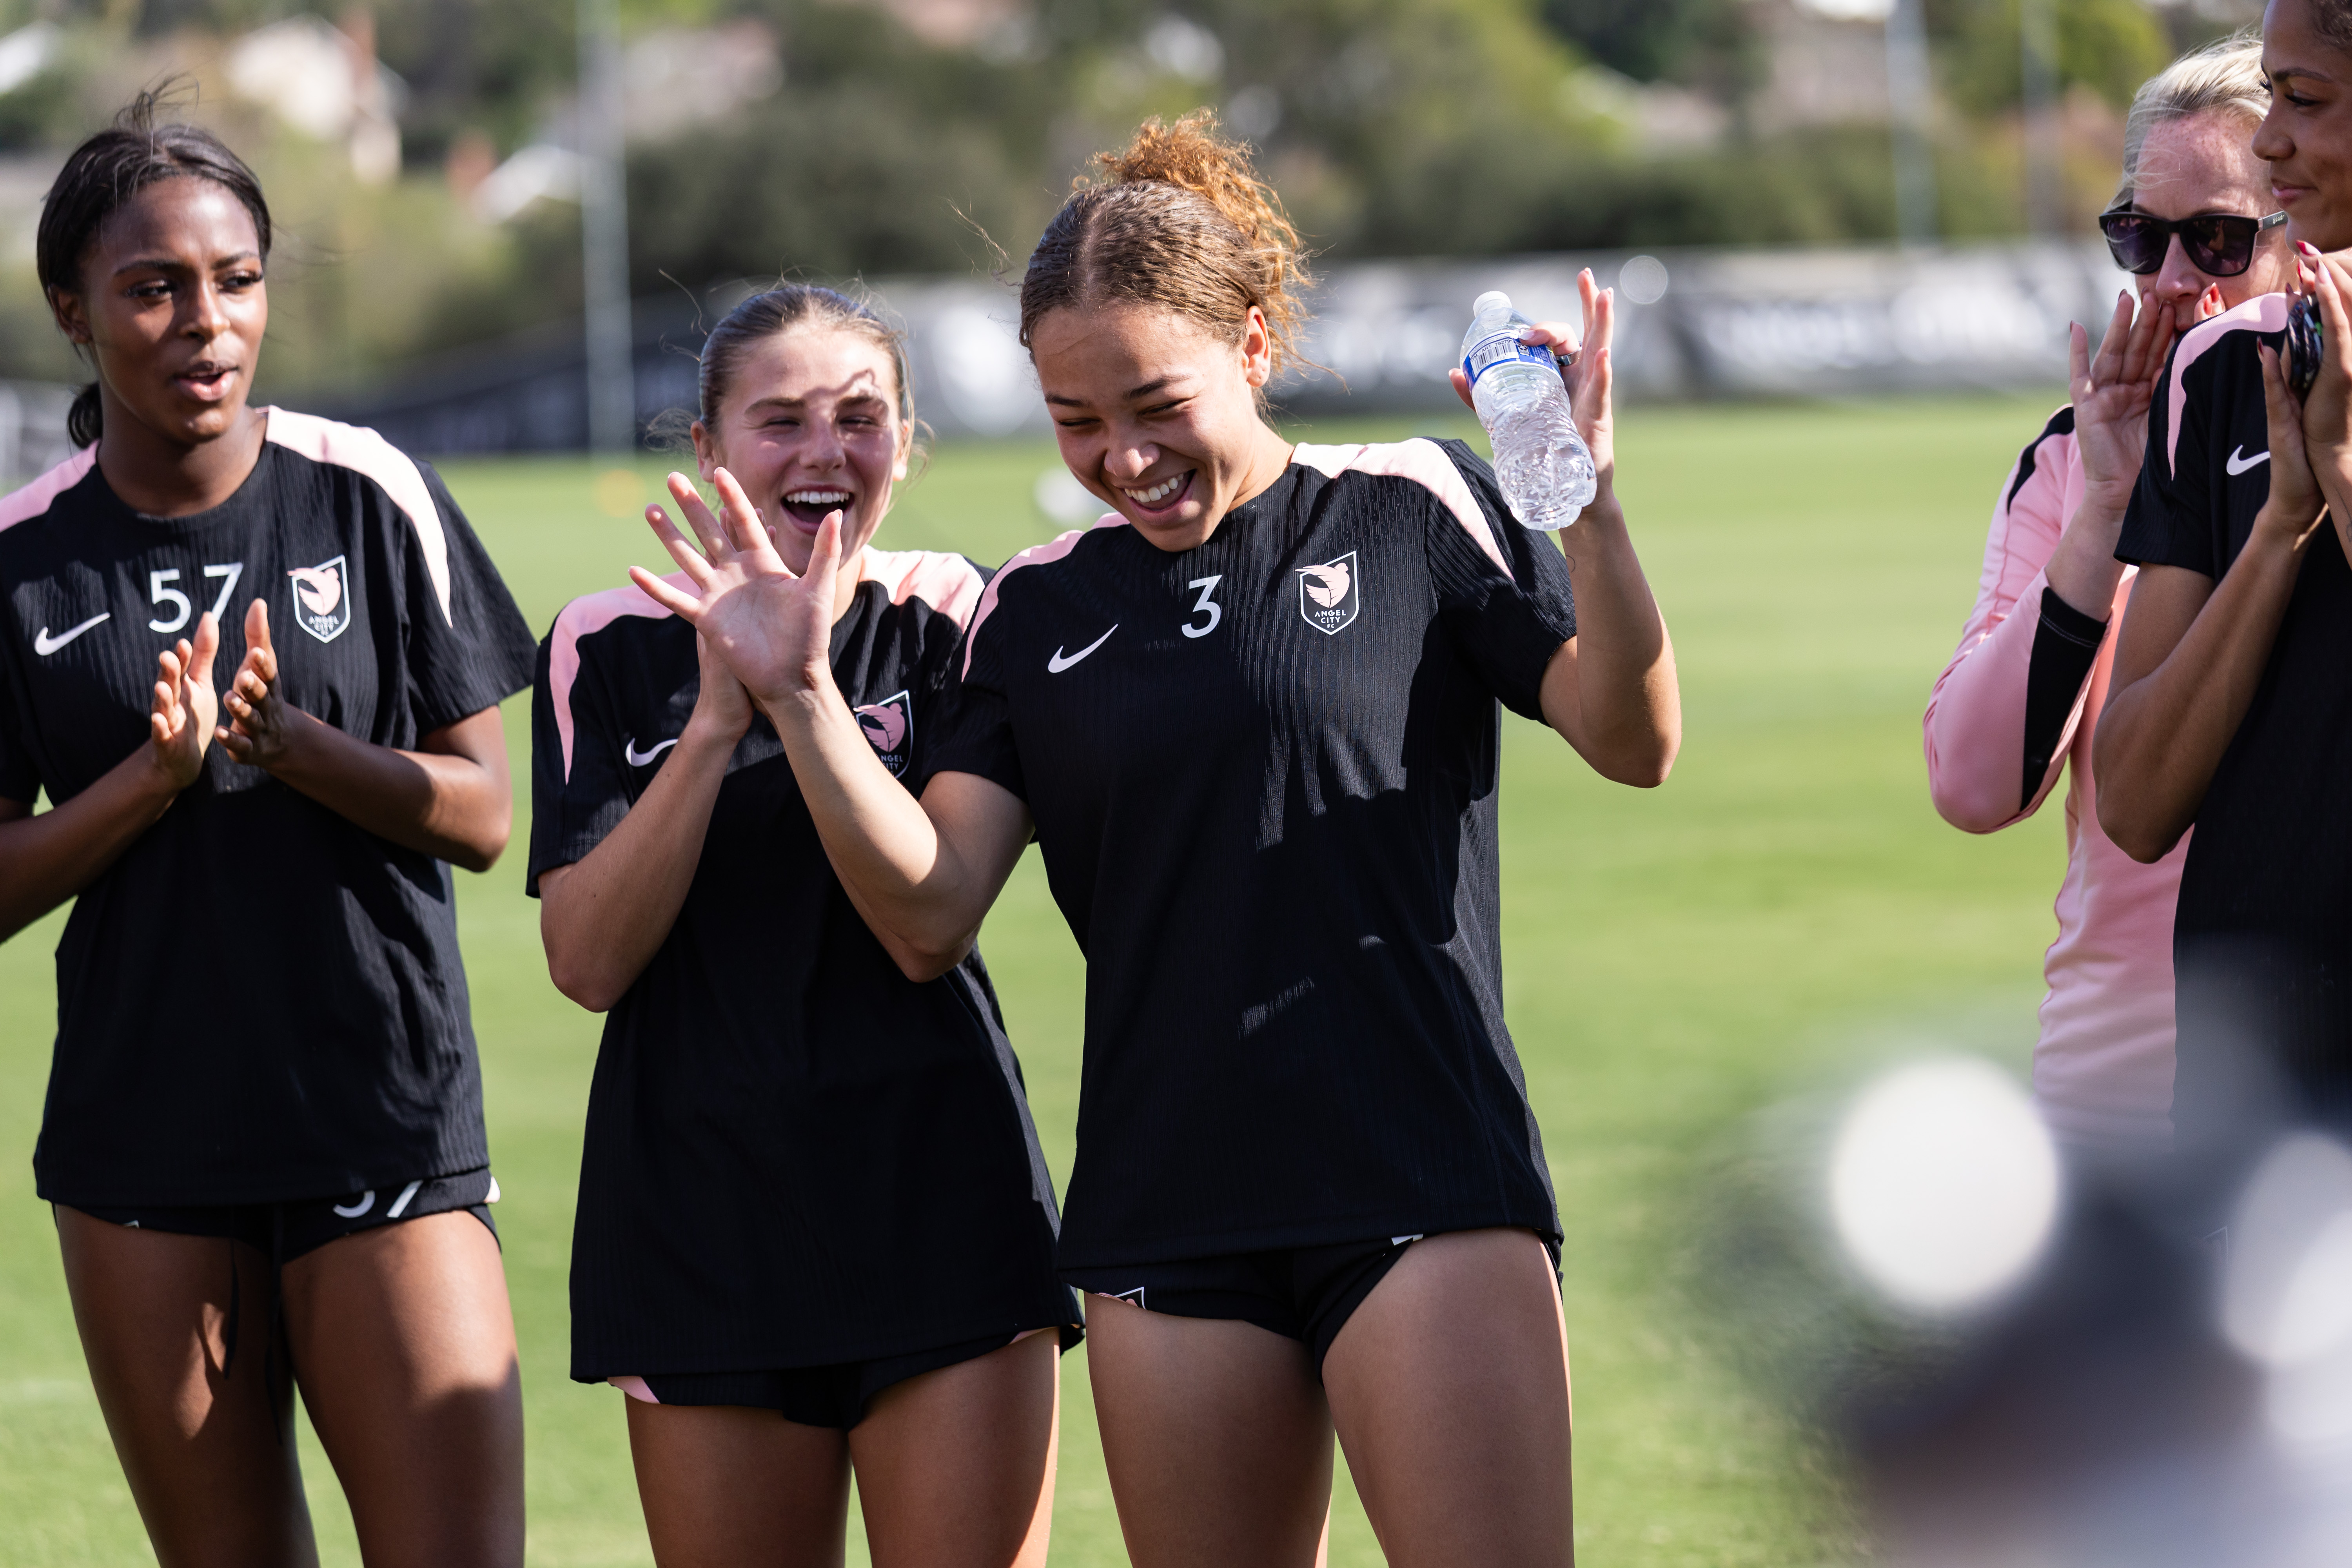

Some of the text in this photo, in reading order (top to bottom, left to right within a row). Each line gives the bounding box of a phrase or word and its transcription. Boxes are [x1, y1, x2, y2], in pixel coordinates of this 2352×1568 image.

[149, 561, 243, 633] 57
[1181, 574, 1223, 639] 3
[1314, 609, 1347, 617] ANGEL
[308, 615, 339, 625] ANGEL
[314, 622, 334, 632] CITY
